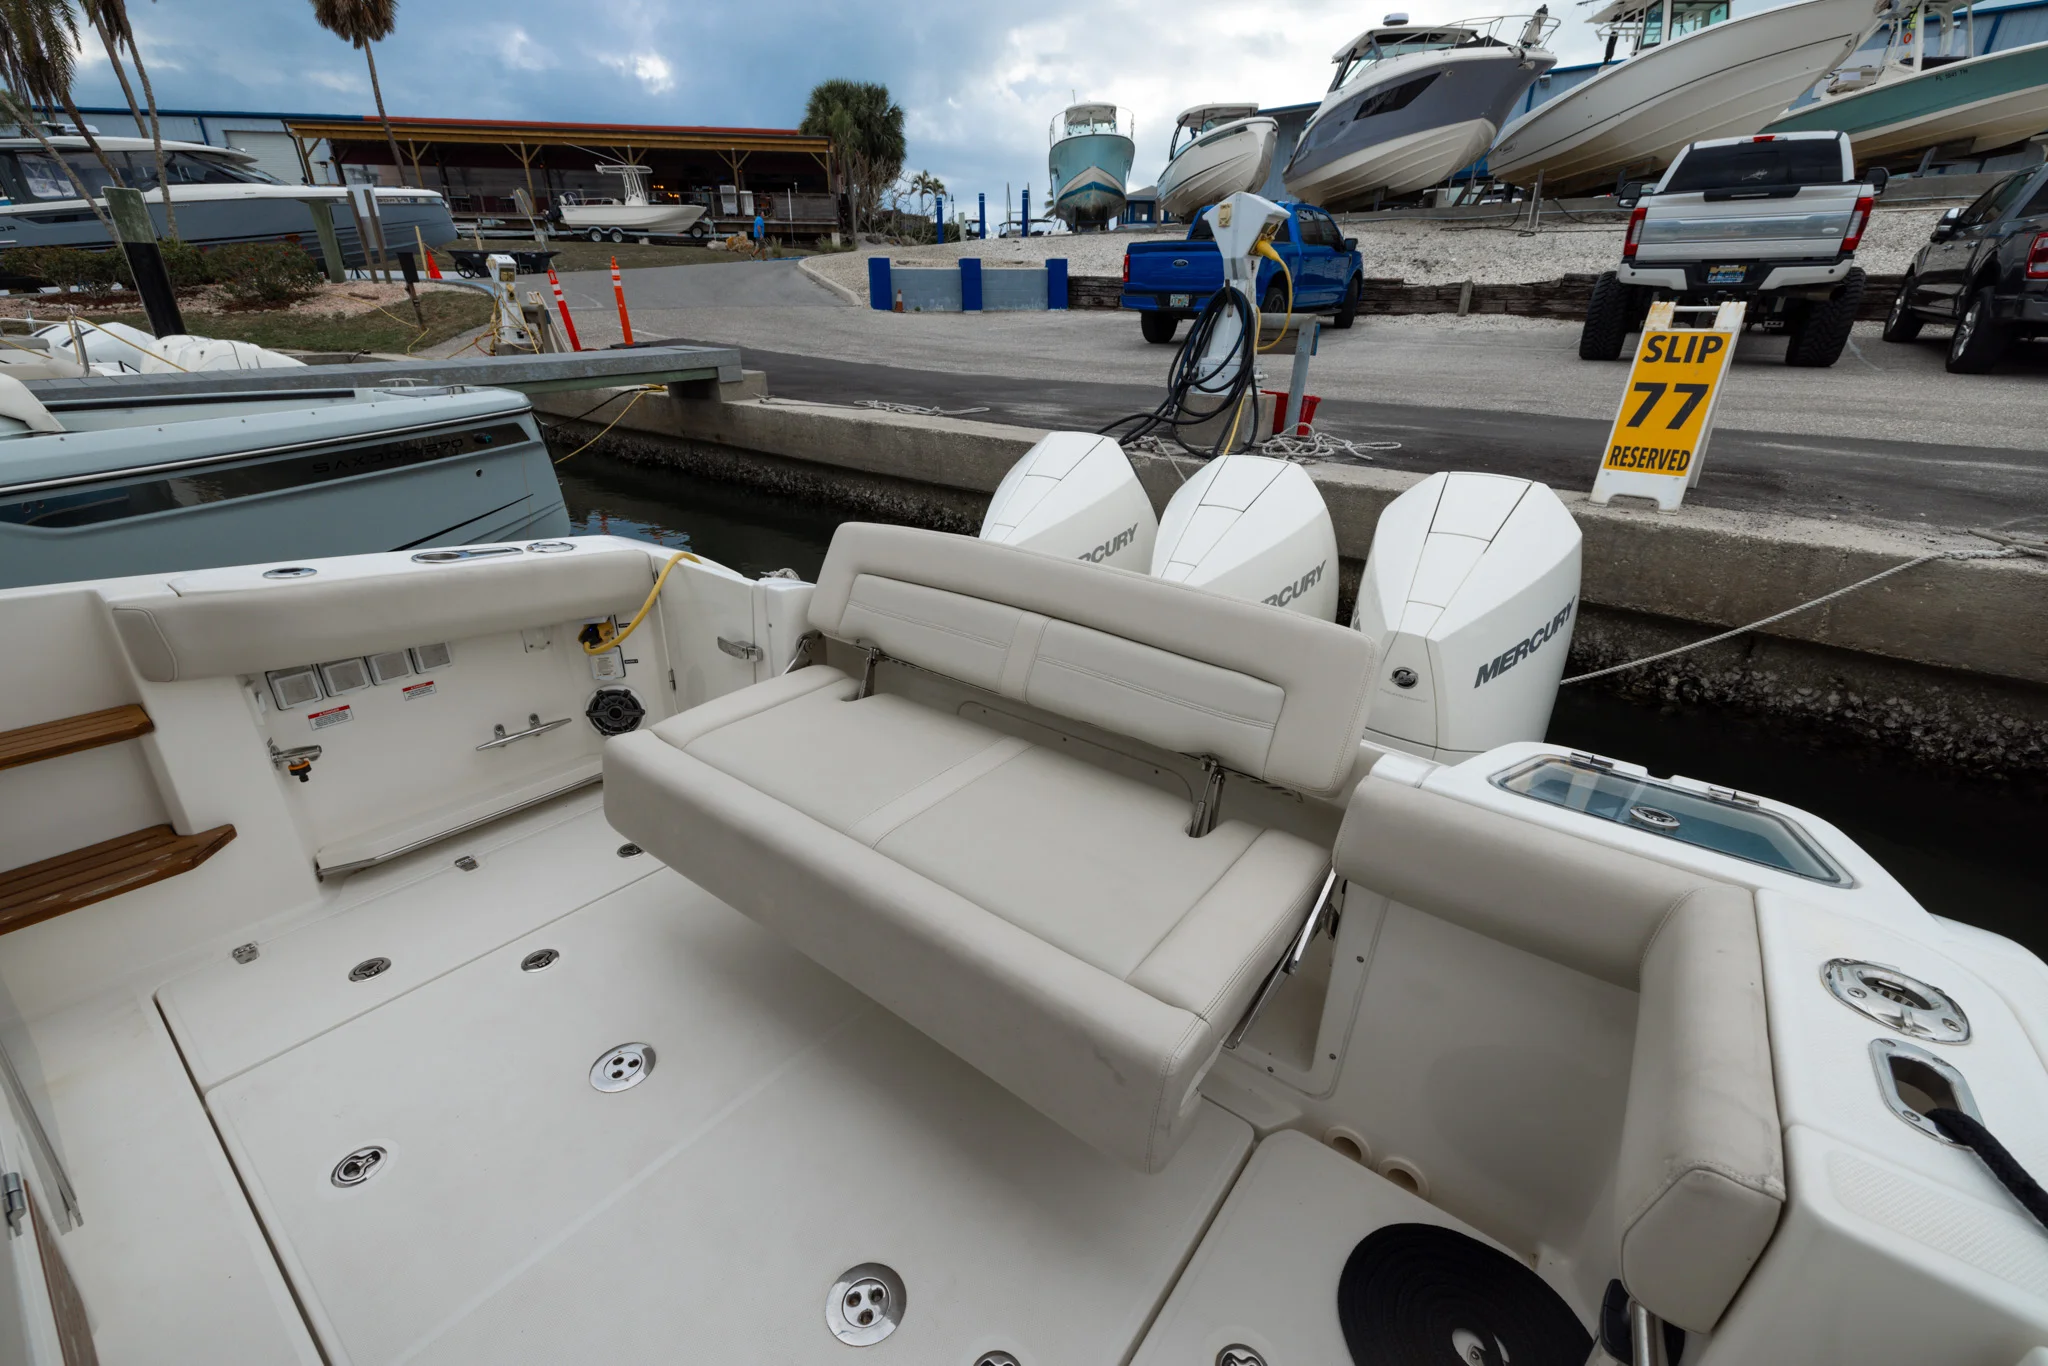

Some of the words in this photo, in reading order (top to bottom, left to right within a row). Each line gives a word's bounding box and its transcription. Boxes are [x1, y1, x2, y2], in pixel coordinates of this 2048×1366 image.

[1642, 335, 1723, 363] SLIP
[1626, 382, 1709, 430] 77
[424, 438, 464, 455] 270
[1609, 445, 1690, 472] RESERVED
[1261, 559, 1327, 607] RCURY
[1474, 594, 1576, 689] MERCURY
